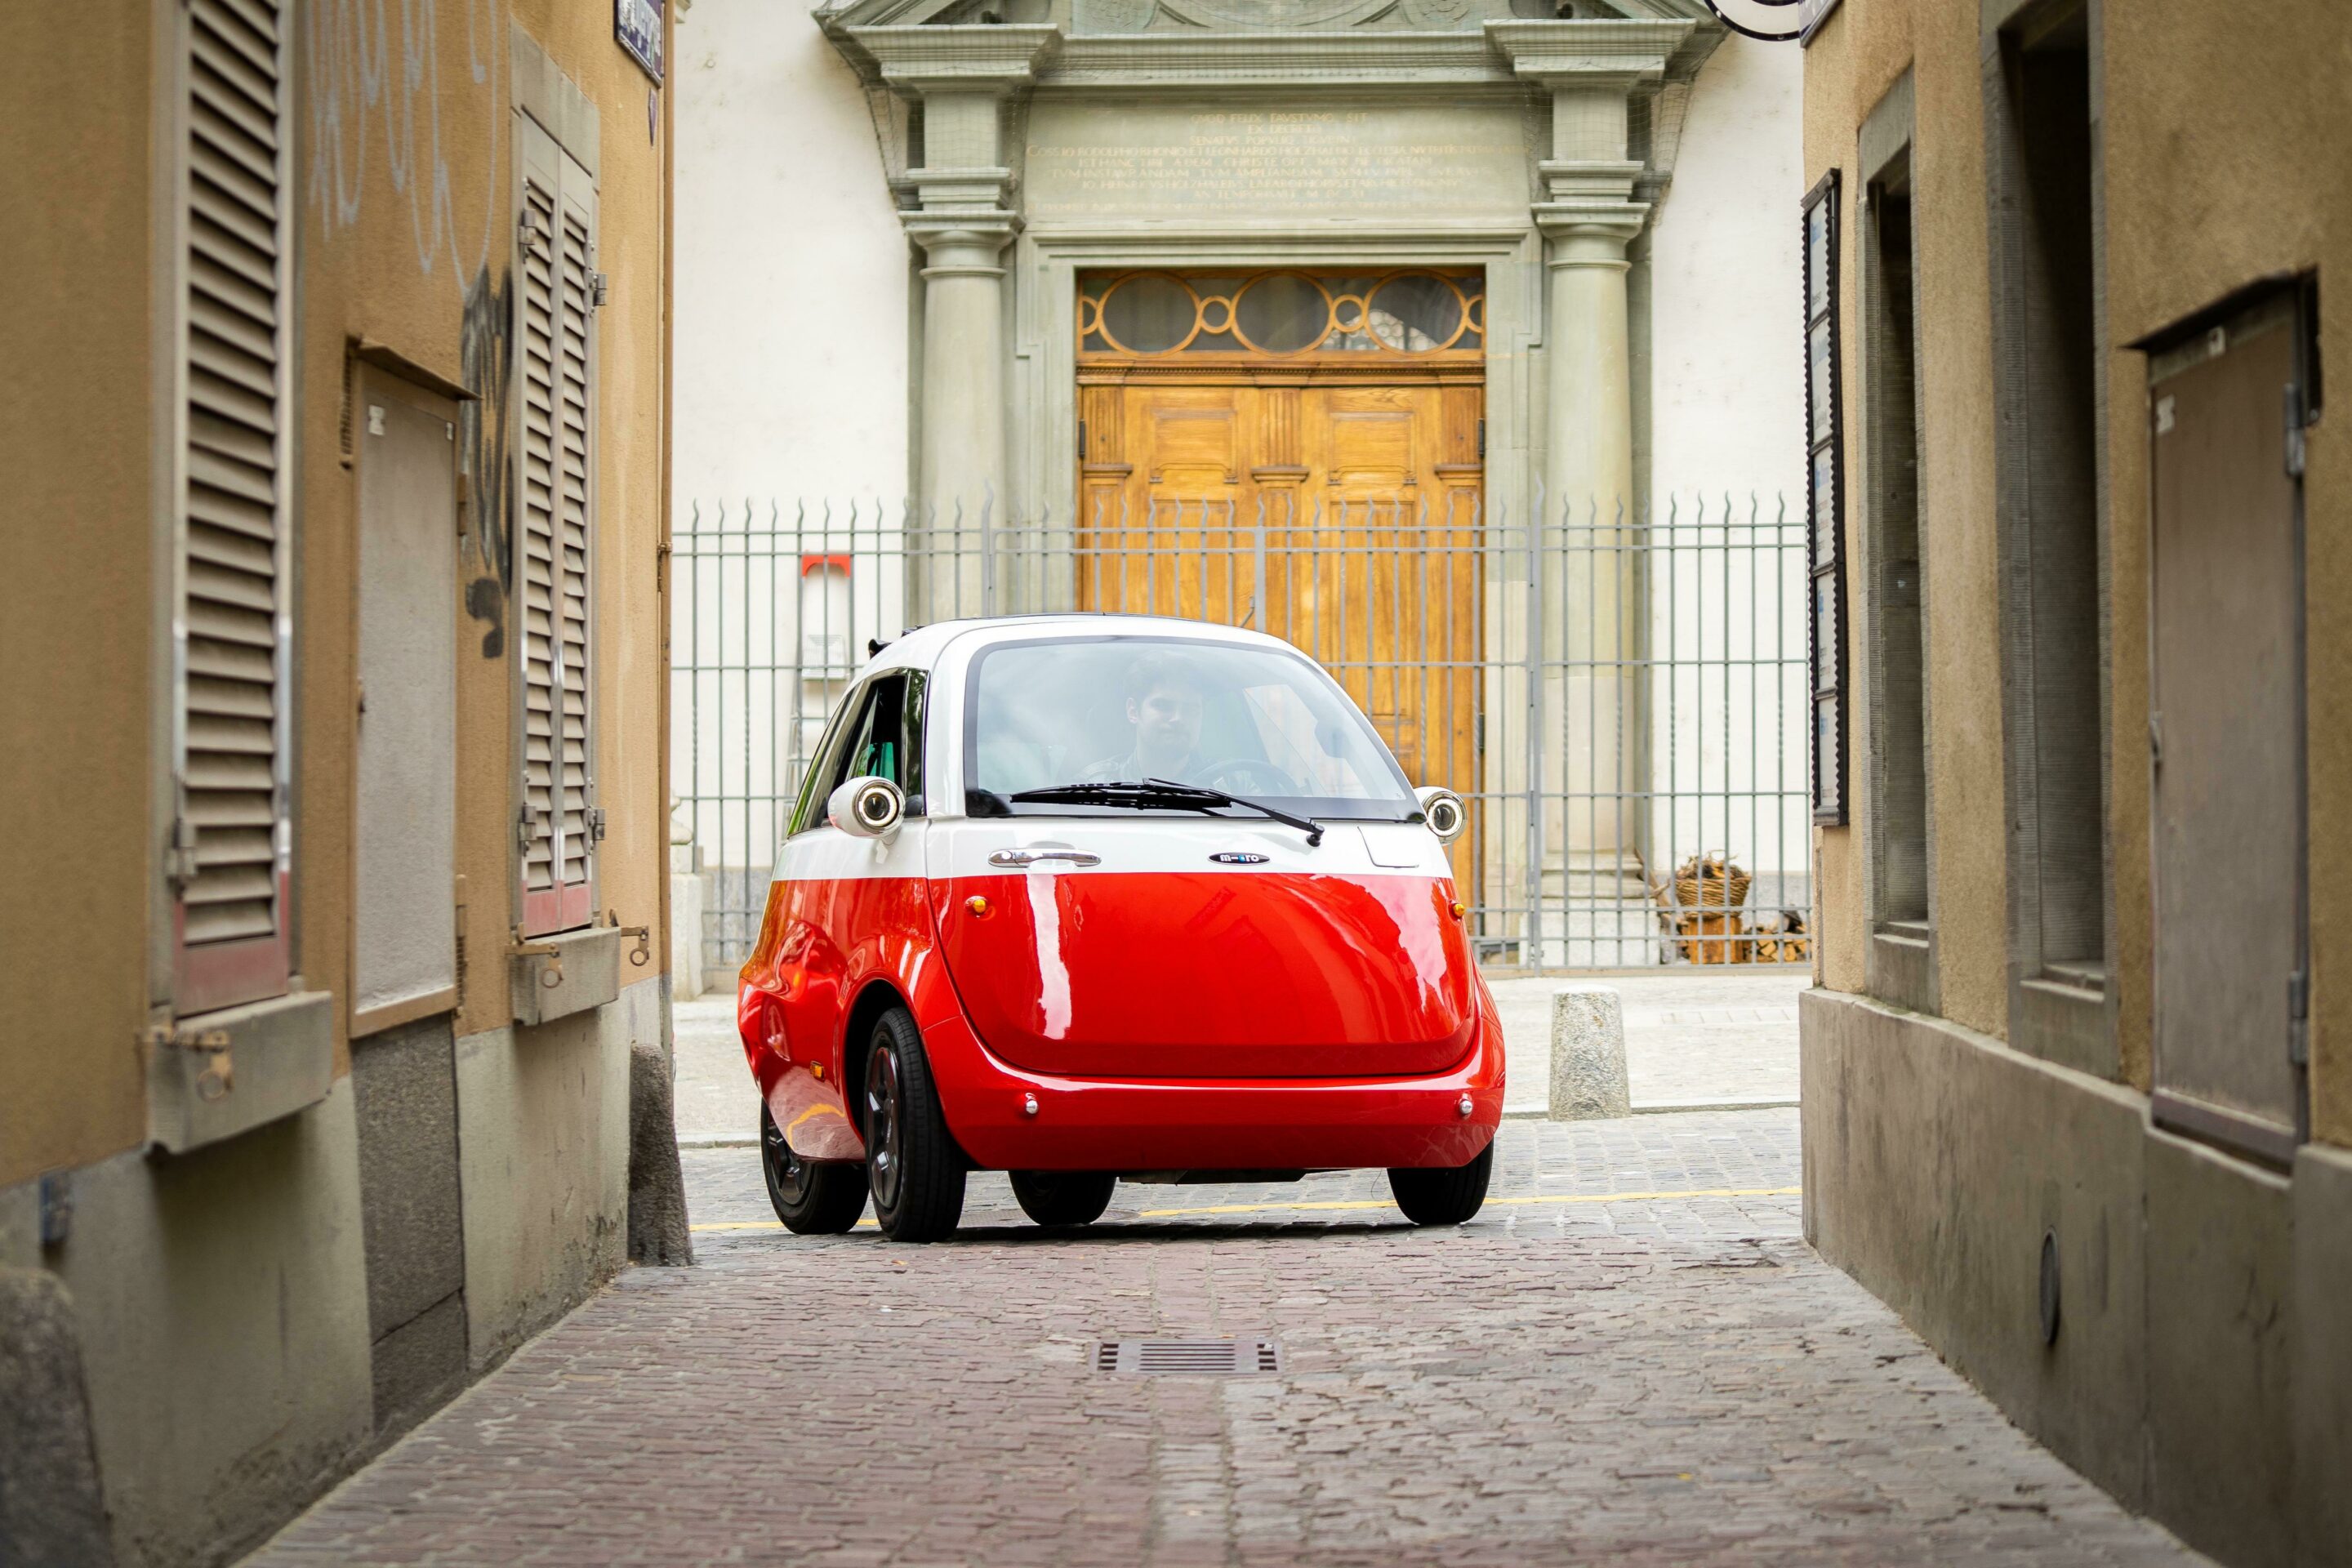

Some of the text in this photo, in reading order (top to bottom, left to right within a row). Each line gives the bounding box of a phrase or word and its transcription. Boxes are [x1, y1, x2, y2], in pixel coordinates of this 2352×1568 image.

[1229, 114, 1263, 123] FELIX
[1347, 114, 1370, 123] SIT
[1247, 124, 1264, 134] EX
[1189, 136, 1240, 145] SENATVS
